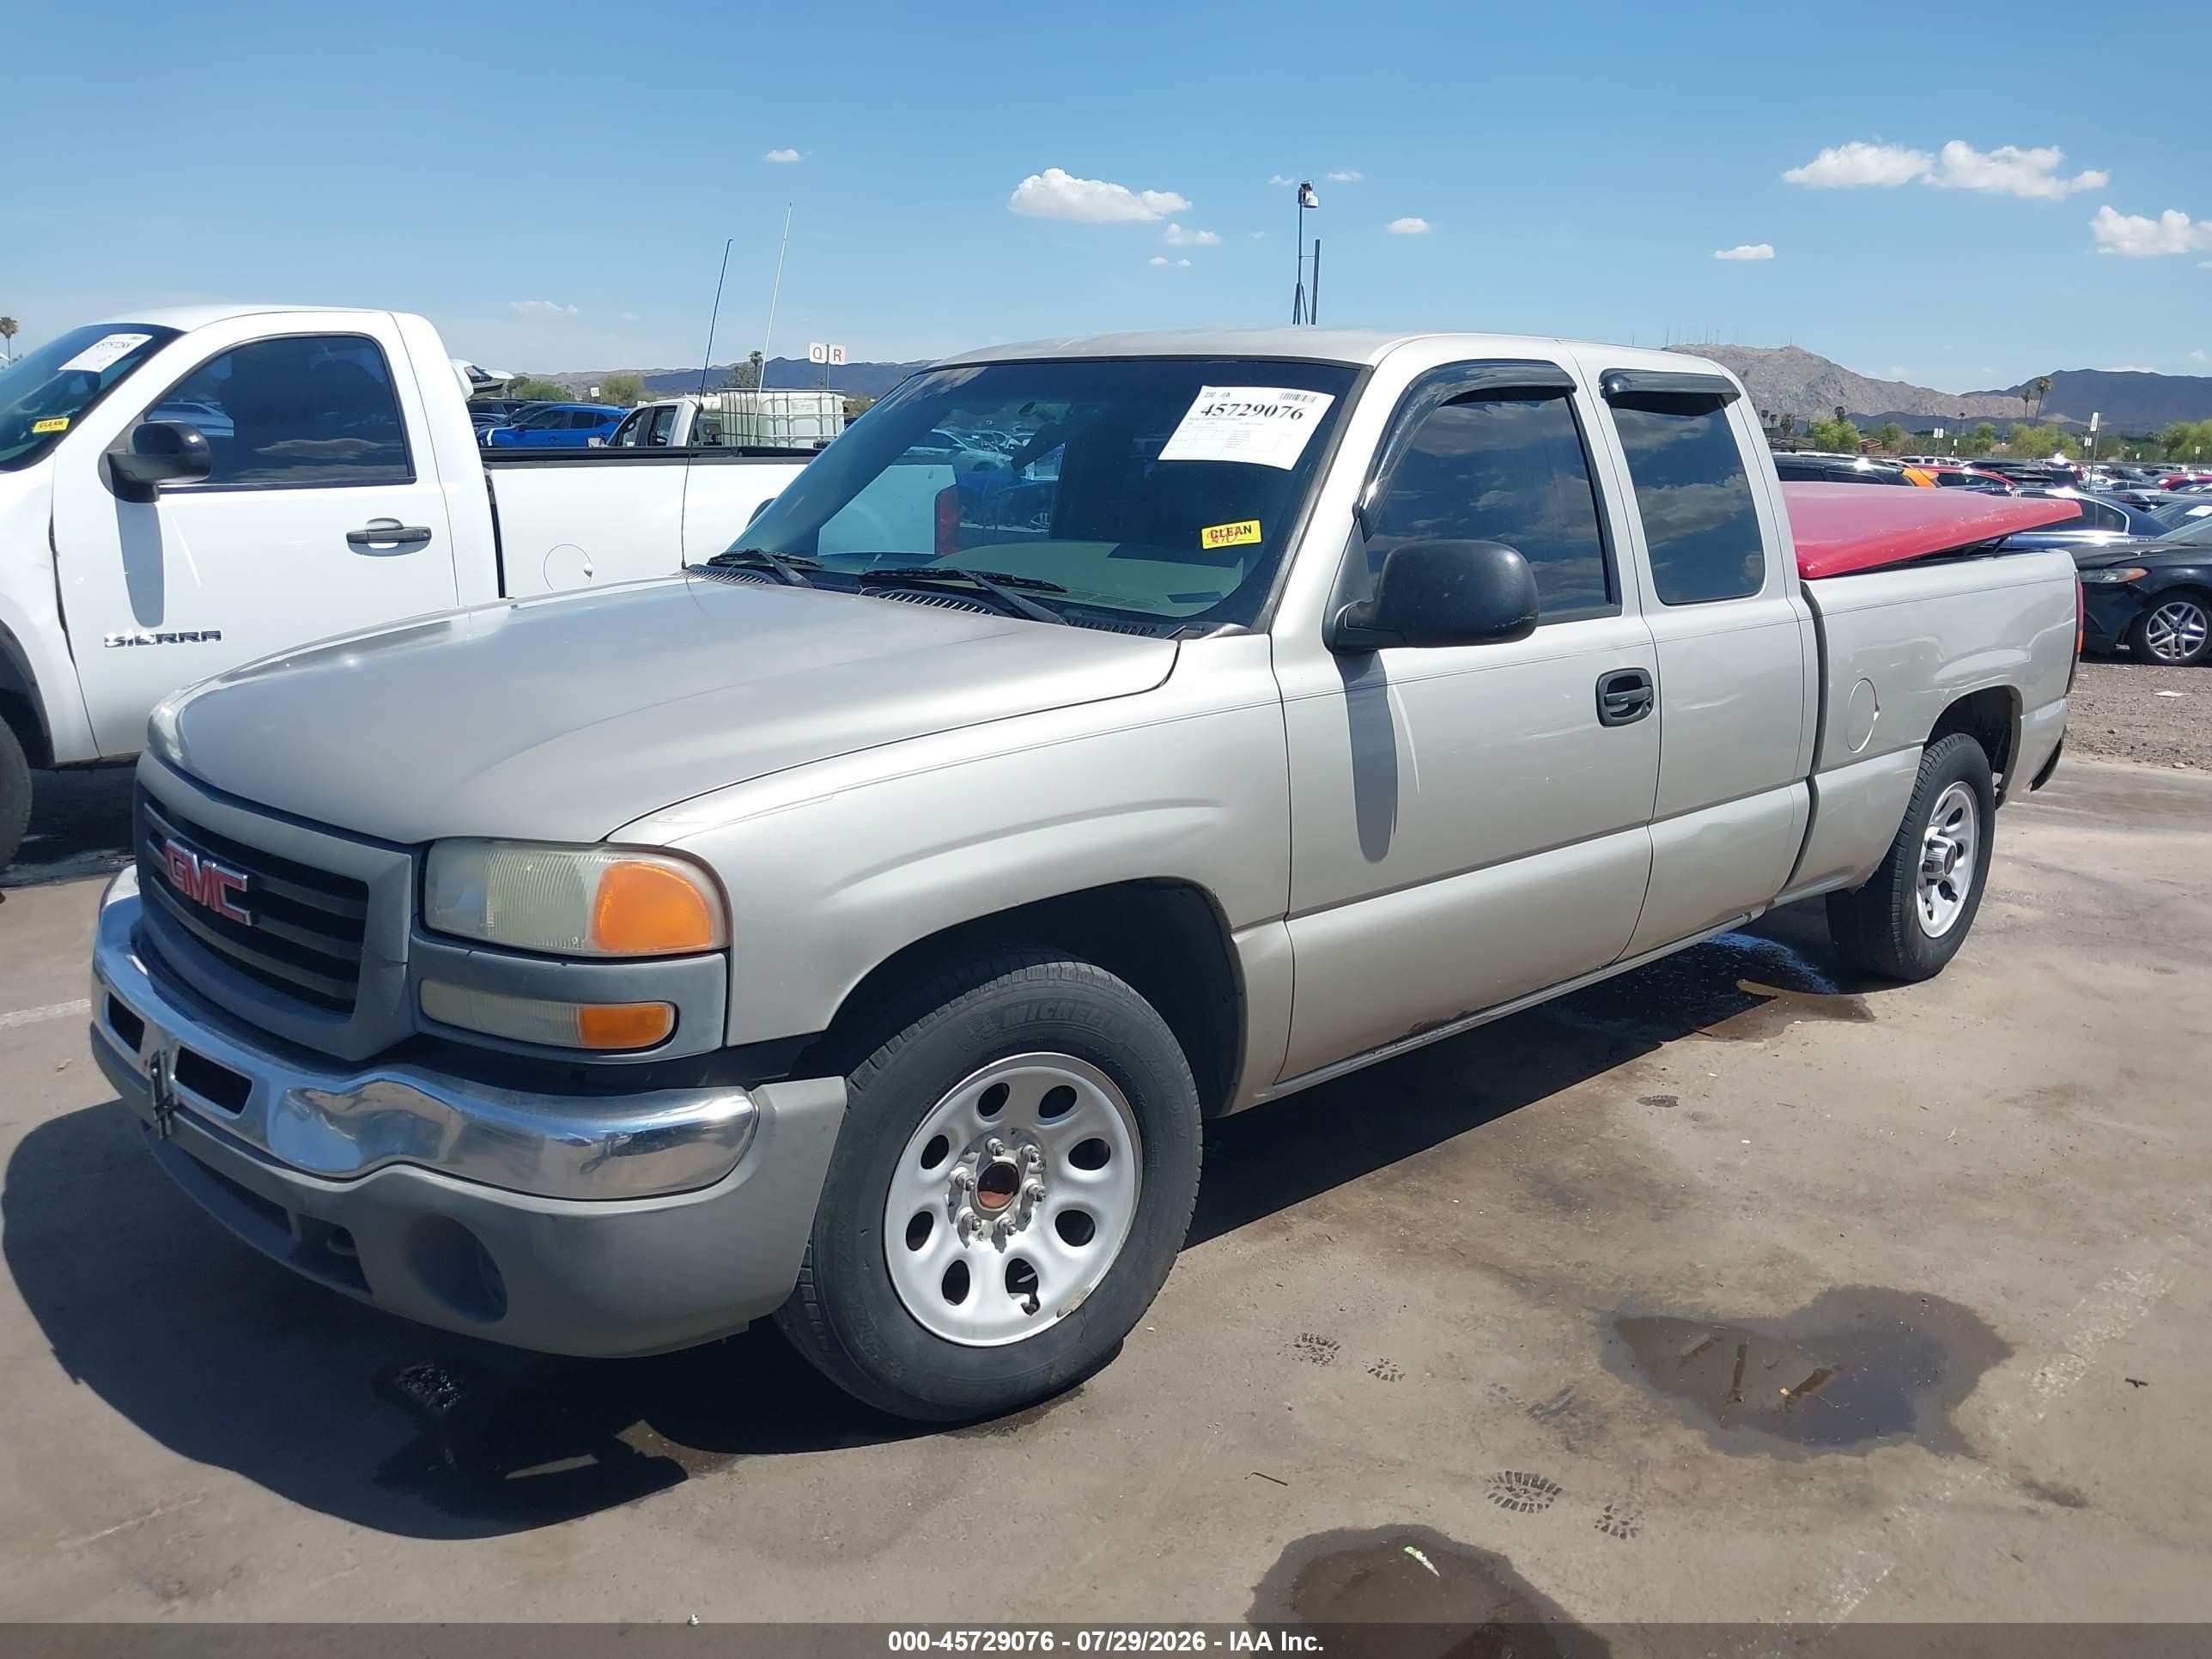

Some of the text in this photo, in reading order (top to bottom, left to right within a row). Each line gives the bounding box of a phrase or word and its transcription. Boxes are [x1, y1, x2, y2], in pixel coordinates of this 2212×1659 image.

[812, 346, 824, 360] Q
[833, 349, 842, 362] R
[1200, 404, 1306, 421] 45729076
[39, 420, 64, 428] CLEAN
[1210, 525, 1252, 538] CLEAN
[104, 630, 222, 647] SIERRA
[164, 839, 252, 927] GMC
